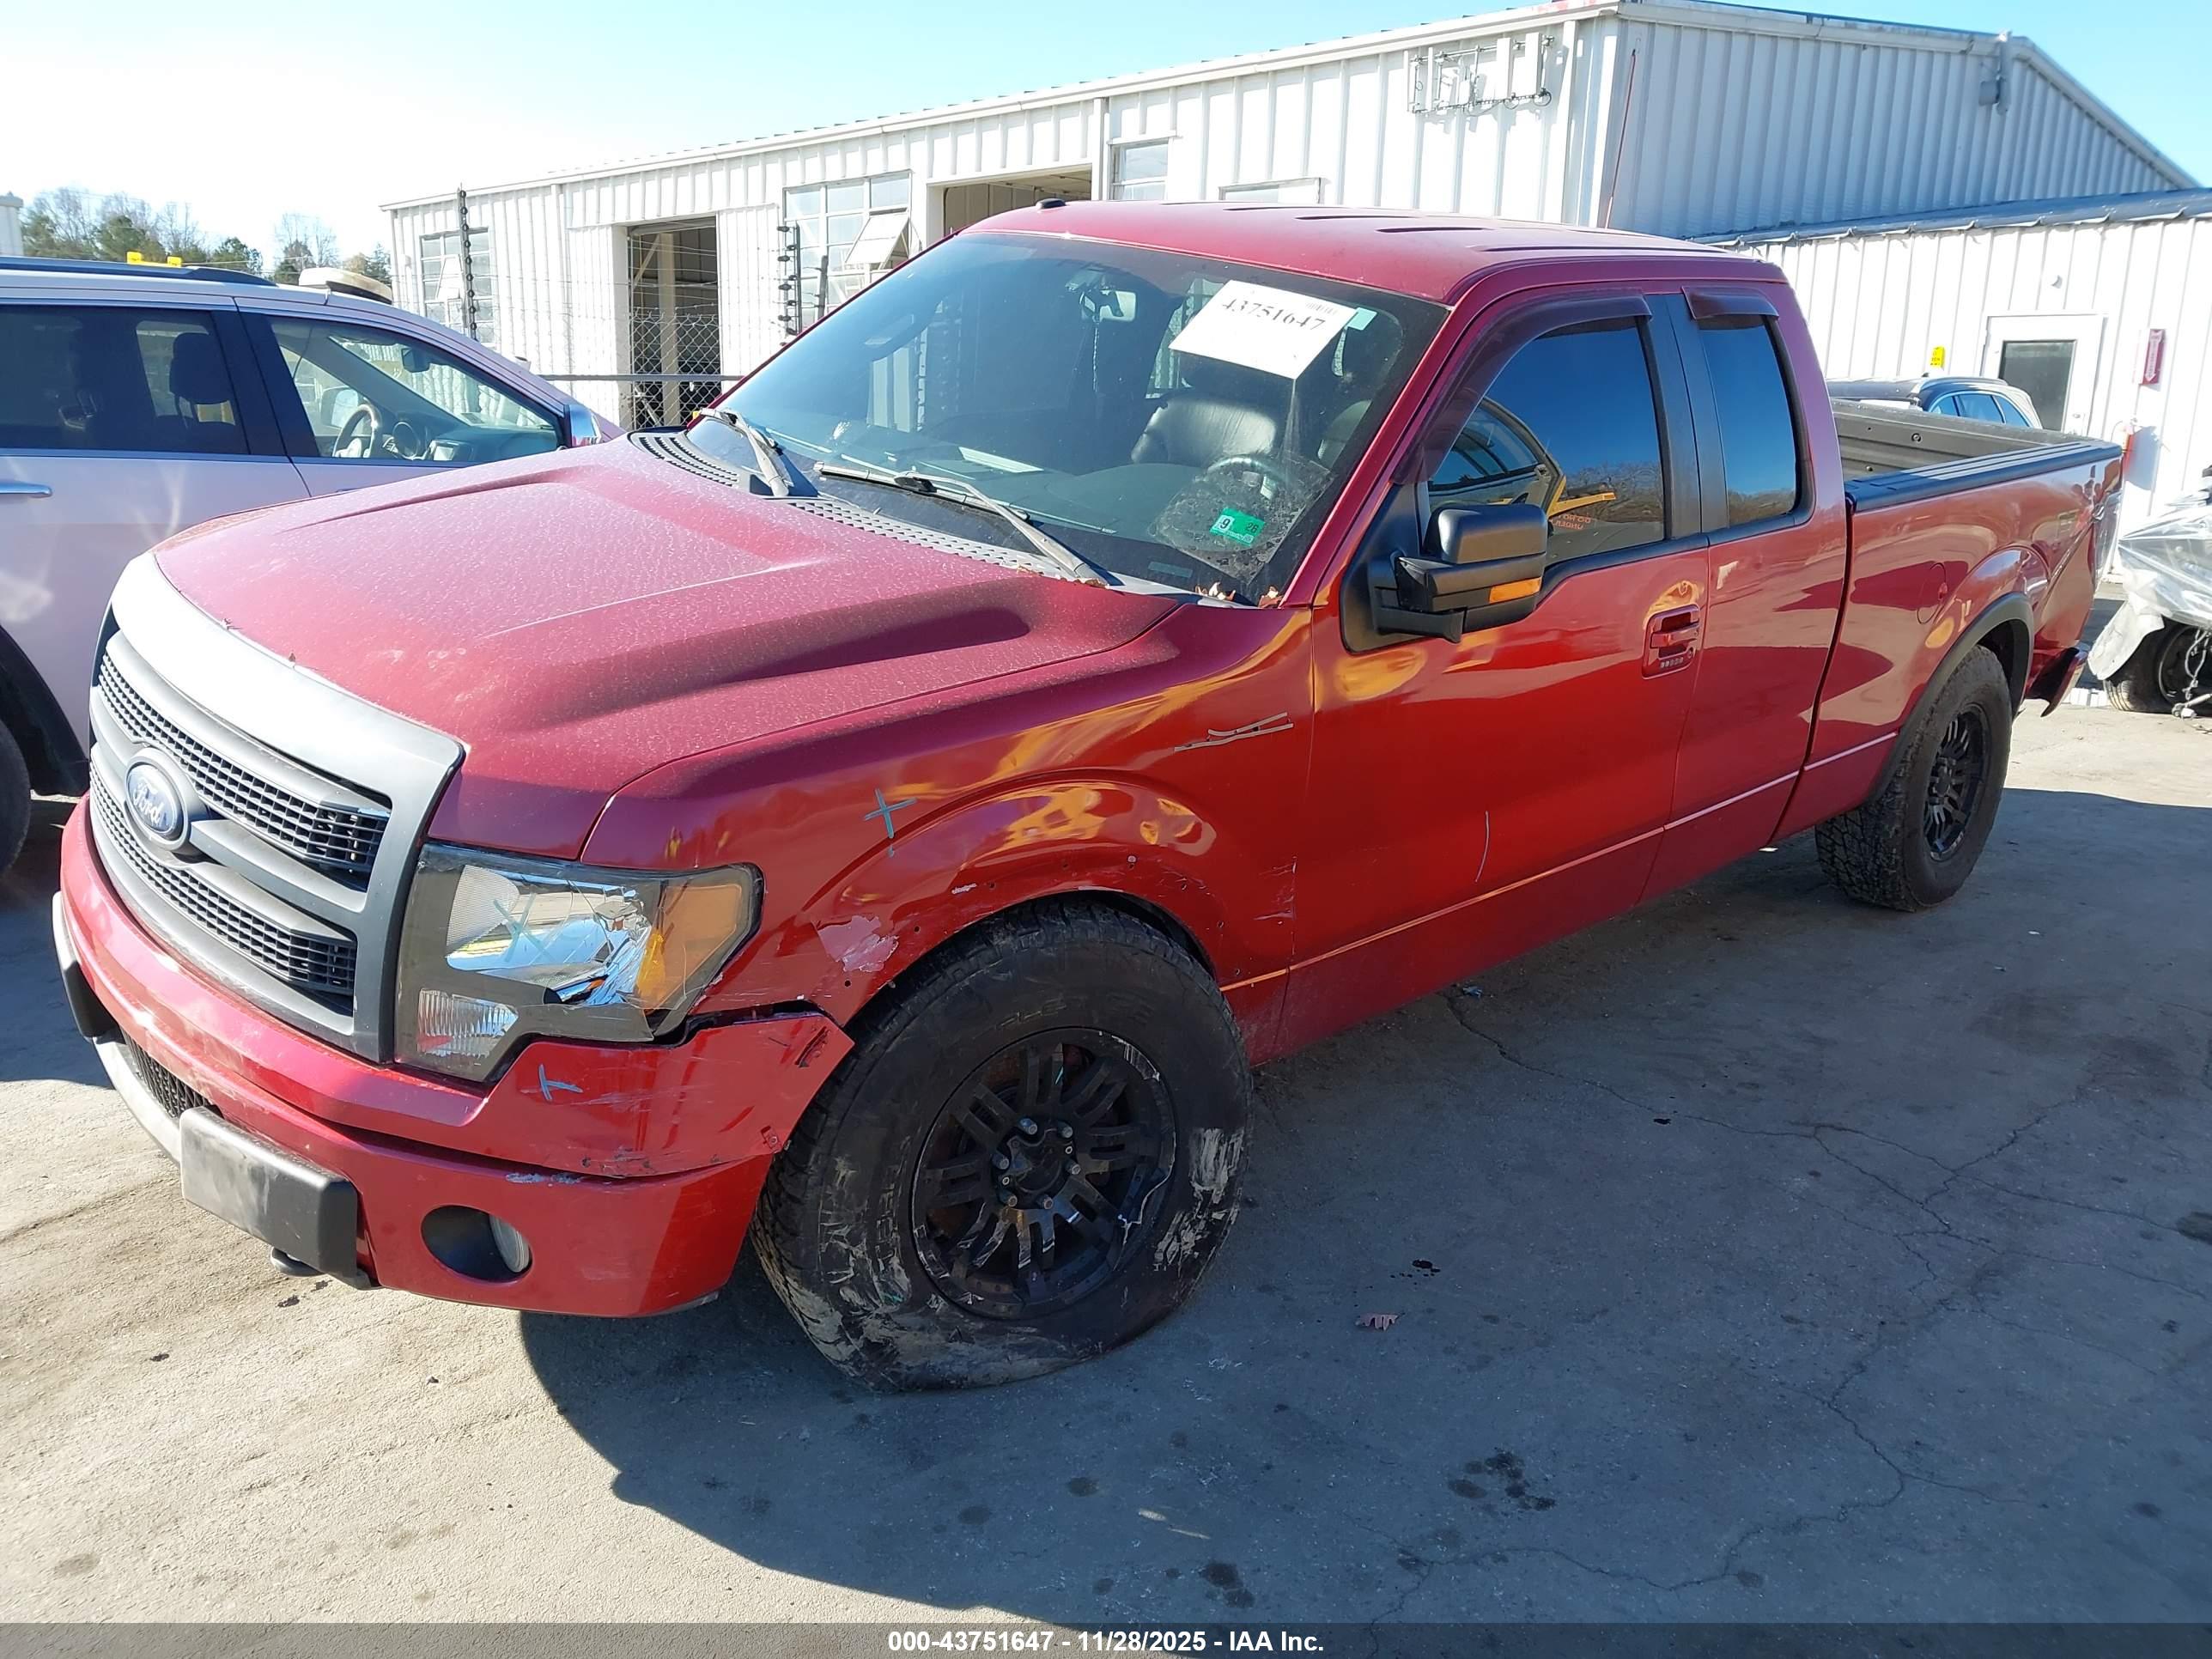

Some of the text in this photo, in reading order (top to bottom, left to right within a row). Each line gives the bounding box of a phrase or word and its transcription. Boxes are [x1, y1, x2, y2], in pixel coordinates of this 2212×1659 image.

[1222, 298, 1326, 331] 43751647
[1220, 518, 1259, 534] 9 26
[131, 777, 167, 827] Ford
